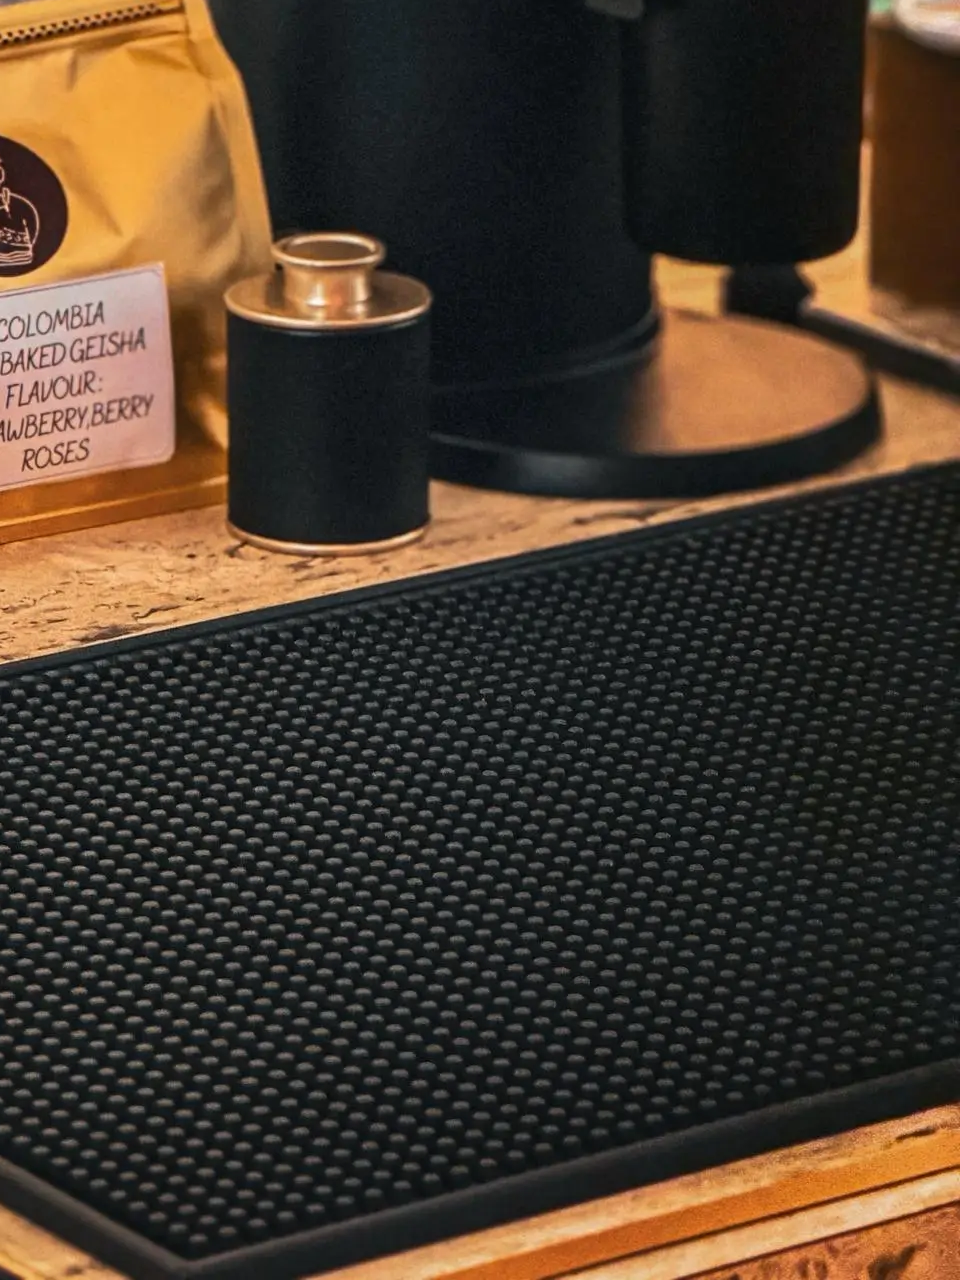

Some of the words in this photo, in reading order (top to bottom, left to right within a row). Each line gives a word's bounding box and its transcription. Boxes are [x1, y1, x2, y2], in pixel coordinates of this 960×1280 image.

[70, 327, 146, 363] GEISHA
[5, 370, 103, 409] FLAVOUR:
[21, 438, 90, 472] ROSES
